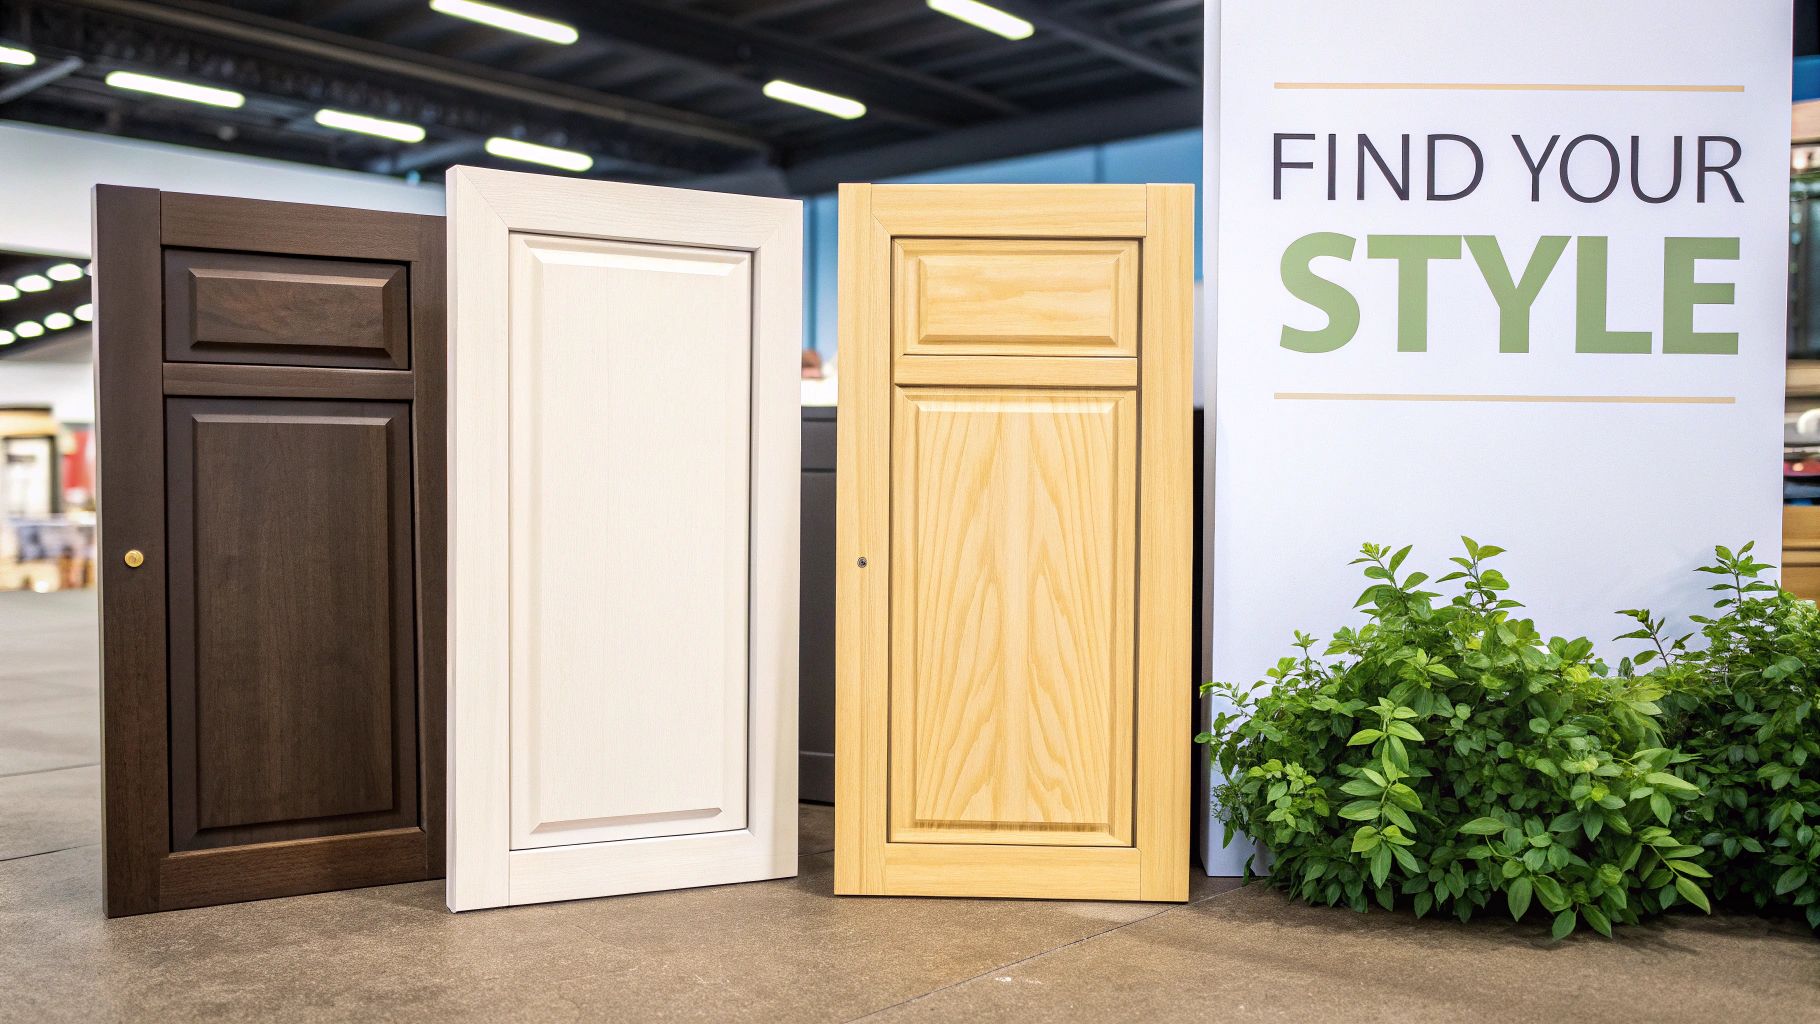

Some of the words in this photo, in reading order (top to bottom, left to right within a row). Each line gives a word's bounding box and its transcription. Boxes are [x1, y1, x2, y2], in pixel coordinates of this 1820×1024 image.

[1273, 132, 1484, 202] FIND
[1511, 134, 1745, 204] YOUR
[1279, 231, 1740, 355] STYLE
